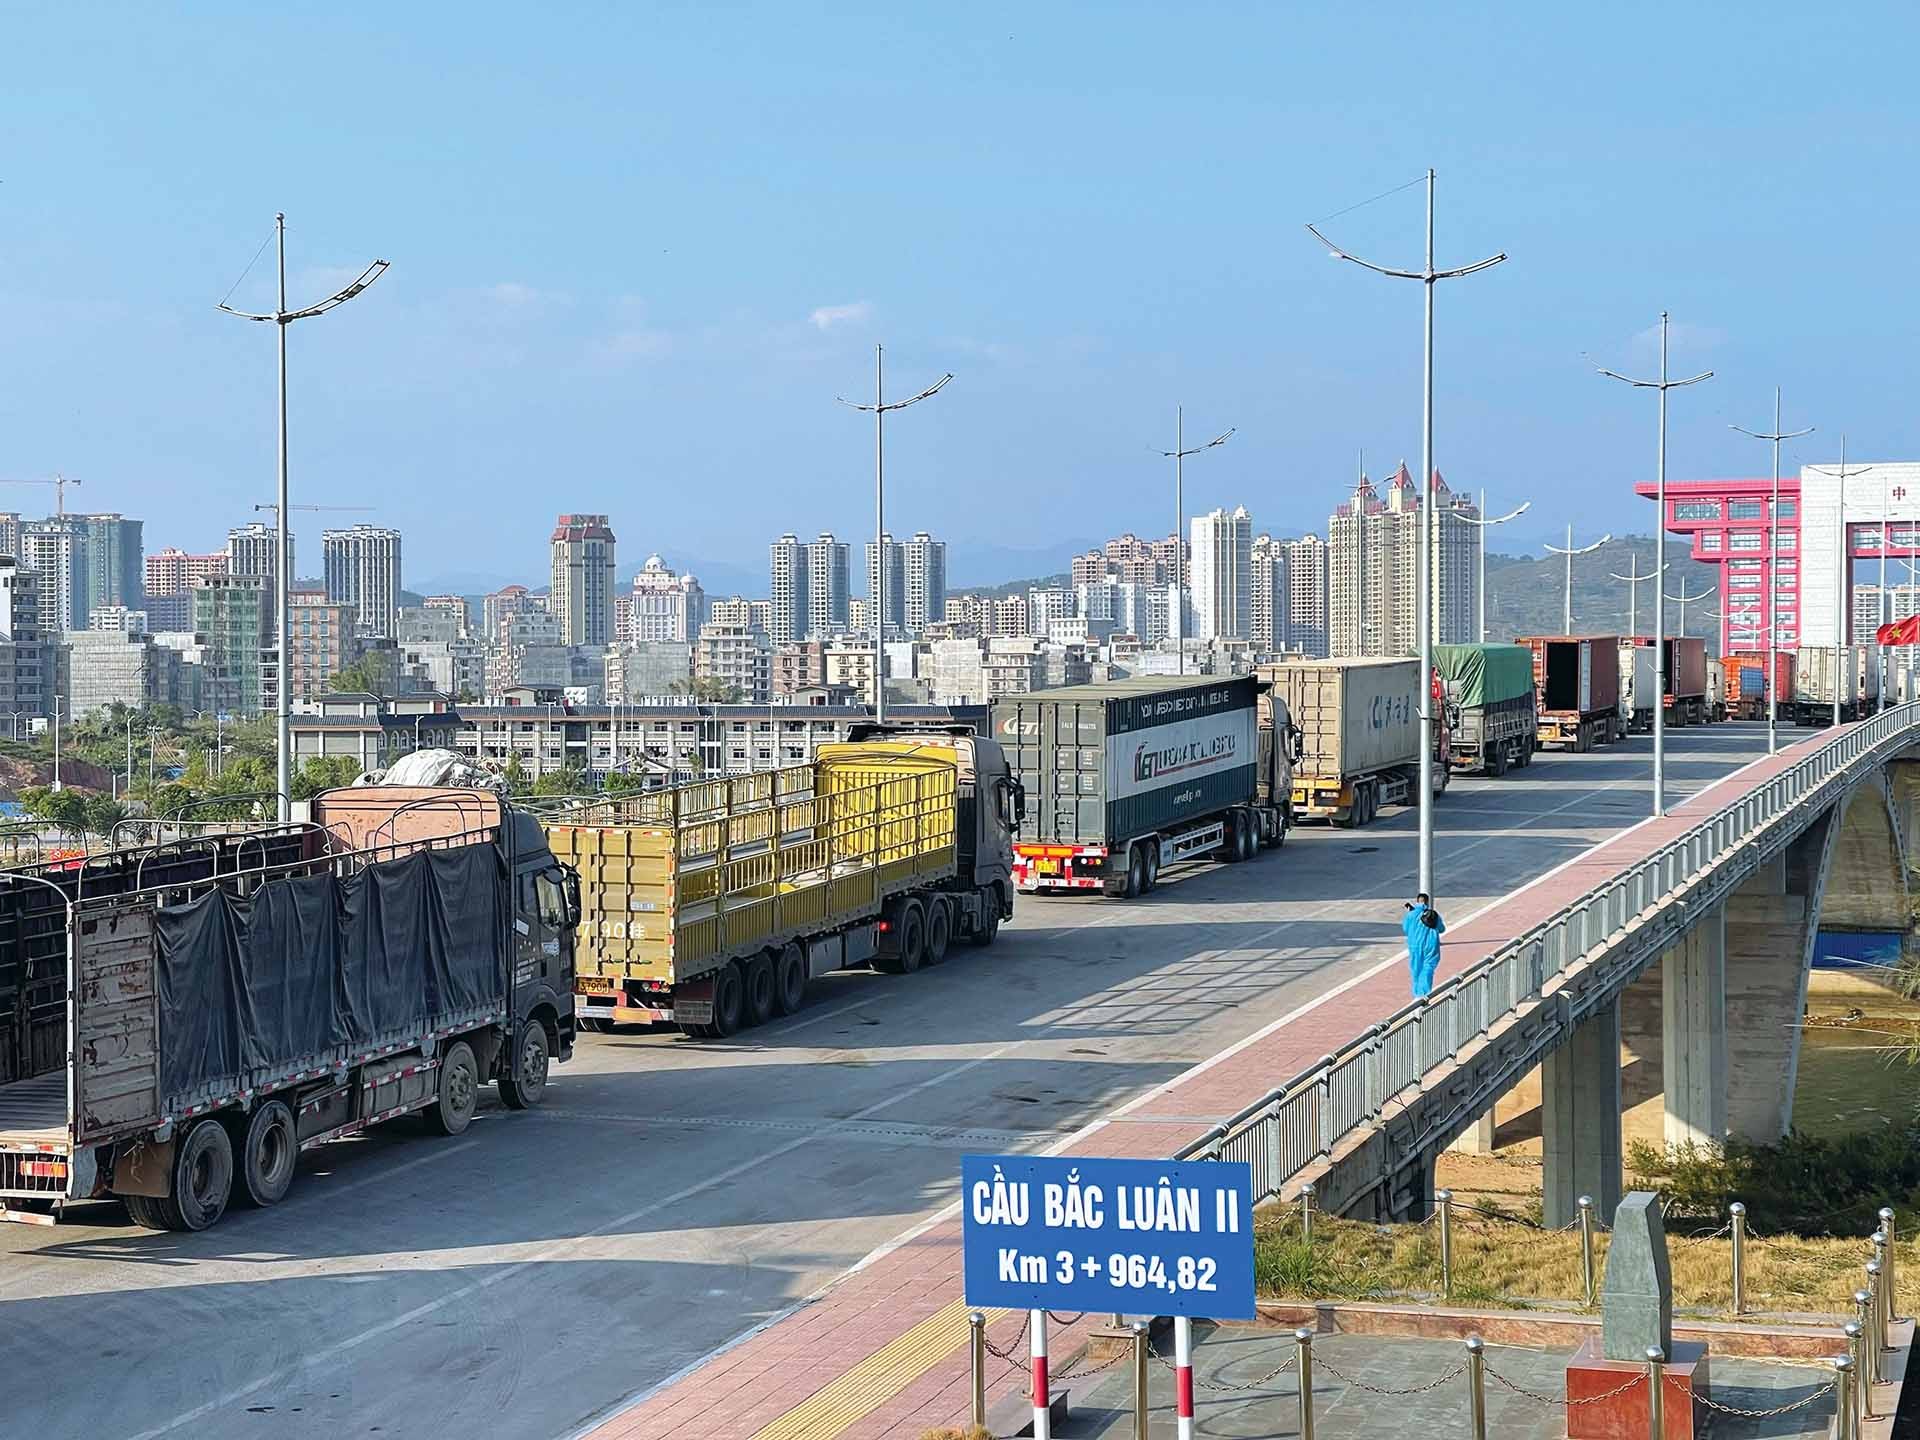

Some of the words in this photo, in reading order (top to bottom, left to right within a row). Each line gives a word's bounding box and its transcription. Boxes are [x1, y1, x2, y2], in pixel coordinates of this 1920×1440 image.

[1892, 485, 1906, 502] 中
[972, 1164, 1030, 1227] CẦU
[1044, 1167, 1104, 1229] BẮC
[1117, 1176, 1201, 1233] LUÂN
[1216, 1188, 1239, 1233] II
[998, 1248, 1048, 1284] Km
[1055, 1250, 1075, 1284] 3
[1108, 1253, 1218, 1294] 964,82
